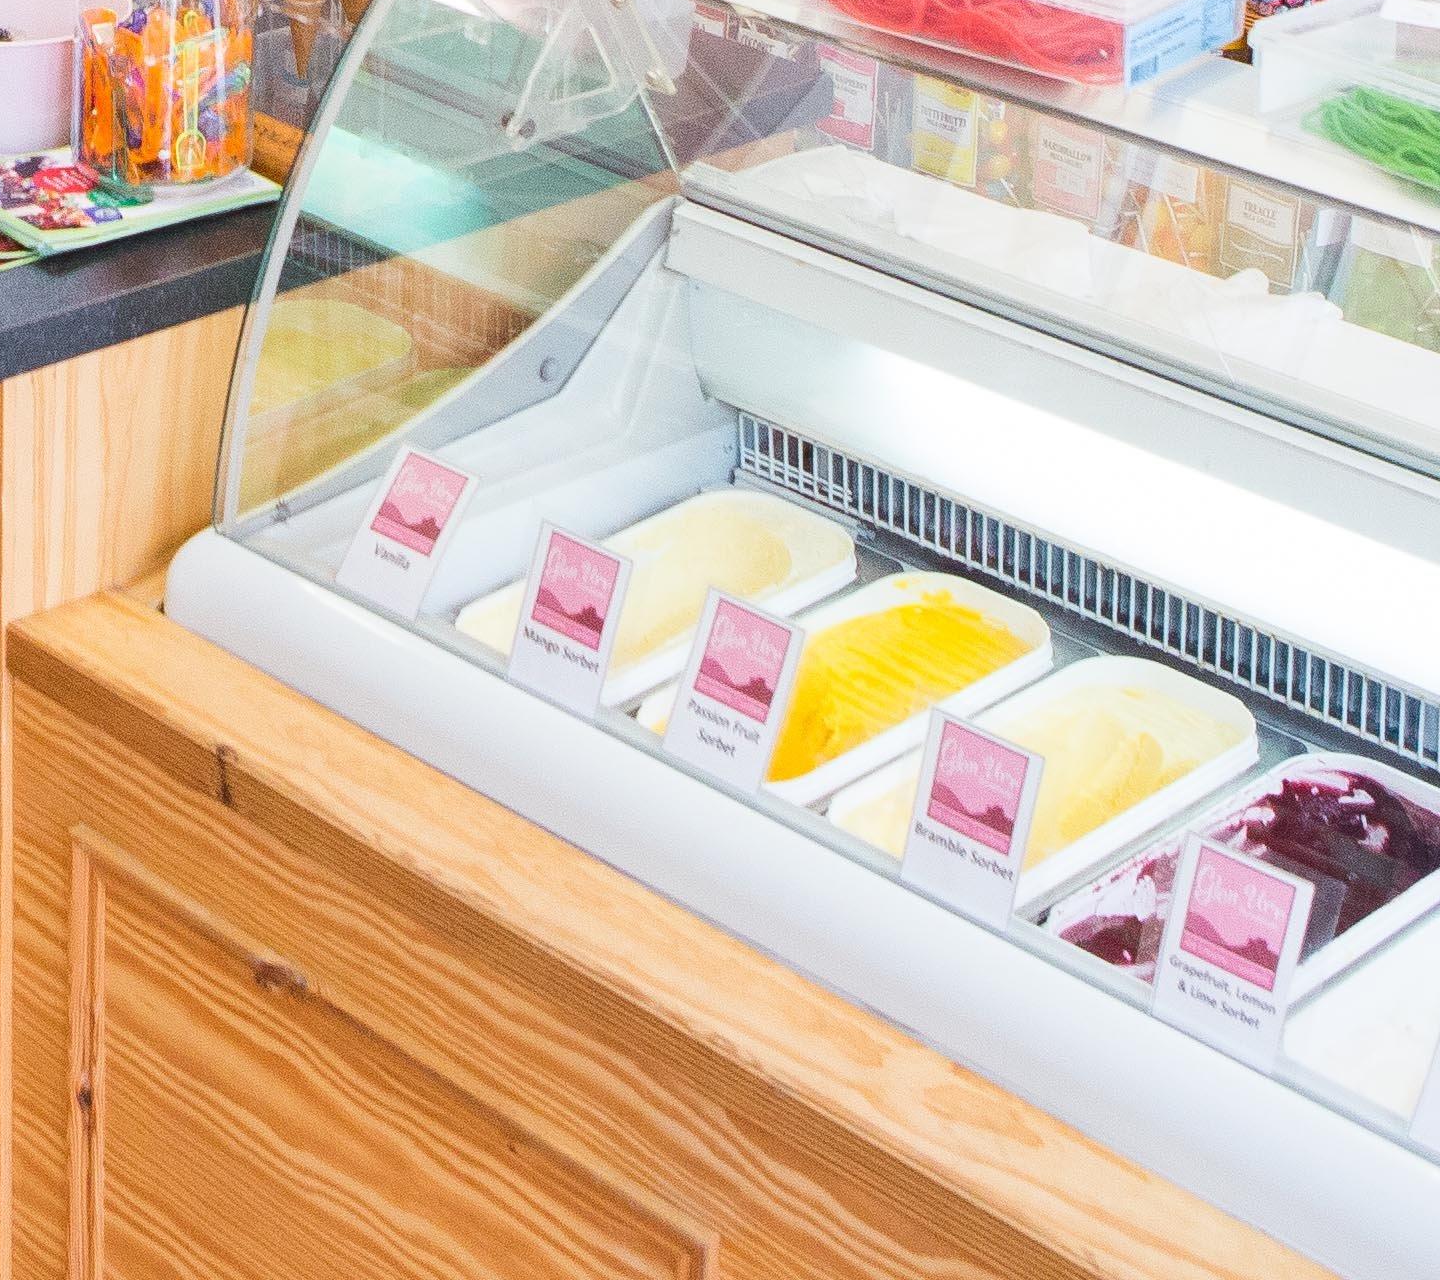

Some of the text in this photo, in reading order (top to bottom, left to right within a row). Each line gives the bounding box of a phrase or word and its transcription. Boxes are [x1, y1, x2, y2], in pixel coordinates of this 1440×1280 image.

[373, 543, 411, 571] Vanilla
[522, 625, 601, 676] Mango Sorbet
[697, 726, 738, 759] Sorbet
[913, 821, 1015, 883] Bramble Sorbet
[1168, 953, 1277, 1016] Grapefruit, Lemon
